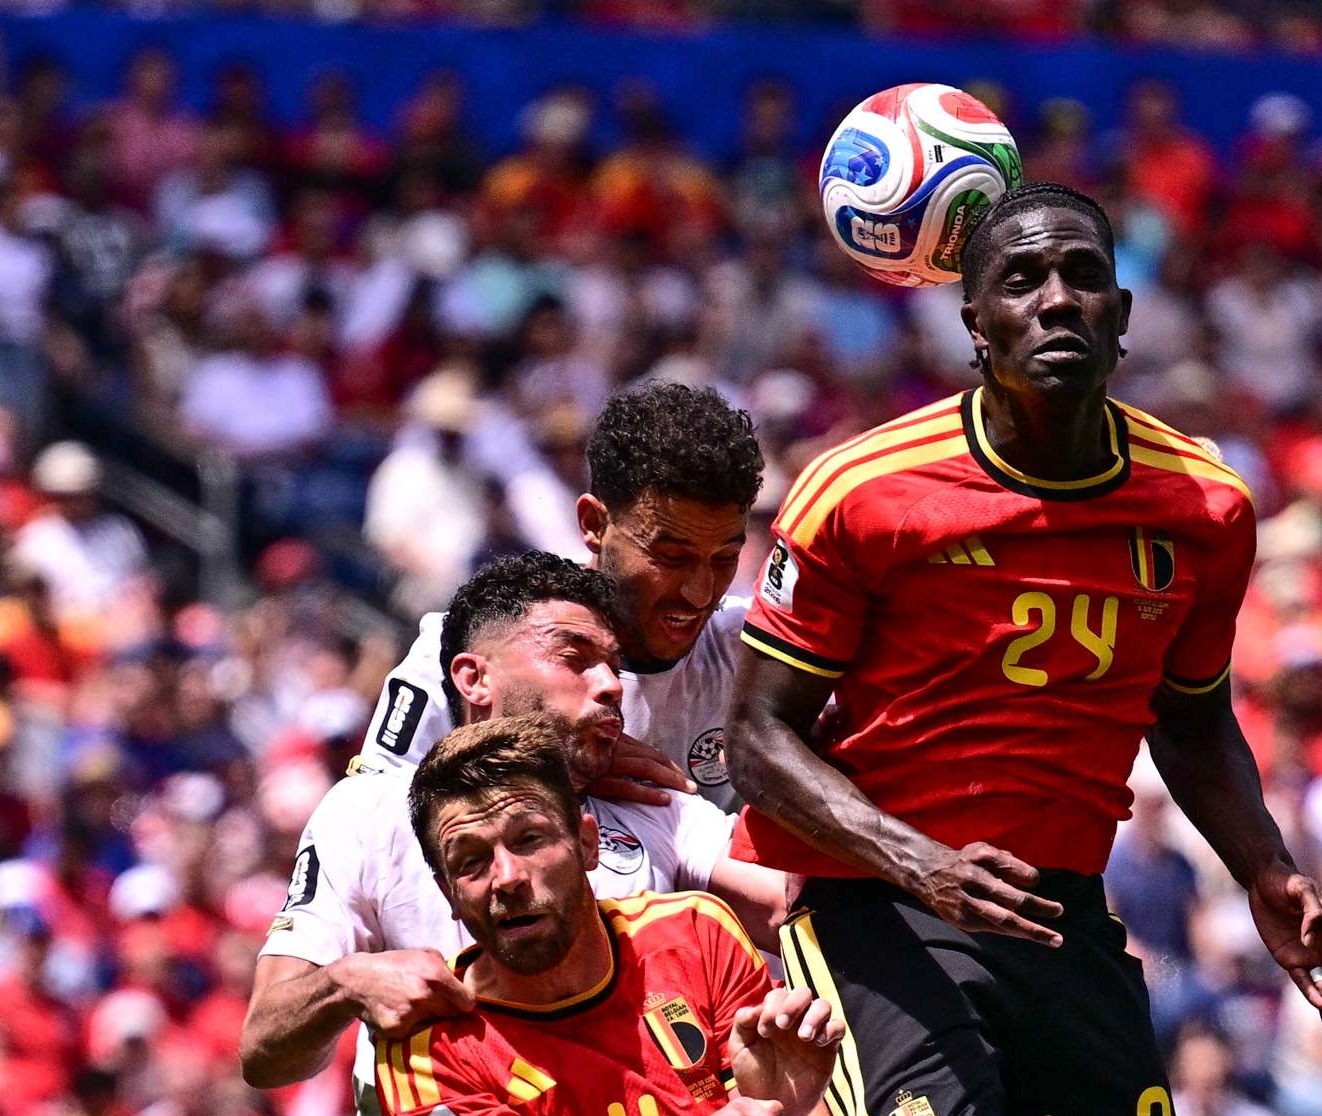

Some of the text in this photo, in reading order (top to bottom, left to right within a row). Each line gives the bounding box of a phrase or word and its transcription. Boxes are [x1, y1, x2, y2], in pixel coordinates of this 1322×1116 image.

[941, 205, 965, 260] TRIONDA
[1002, 591, 1119, 687] 24
[661, 1002, 678, 1012] ROYAL
[664, 1004, 687, 1017] BELGIAN
